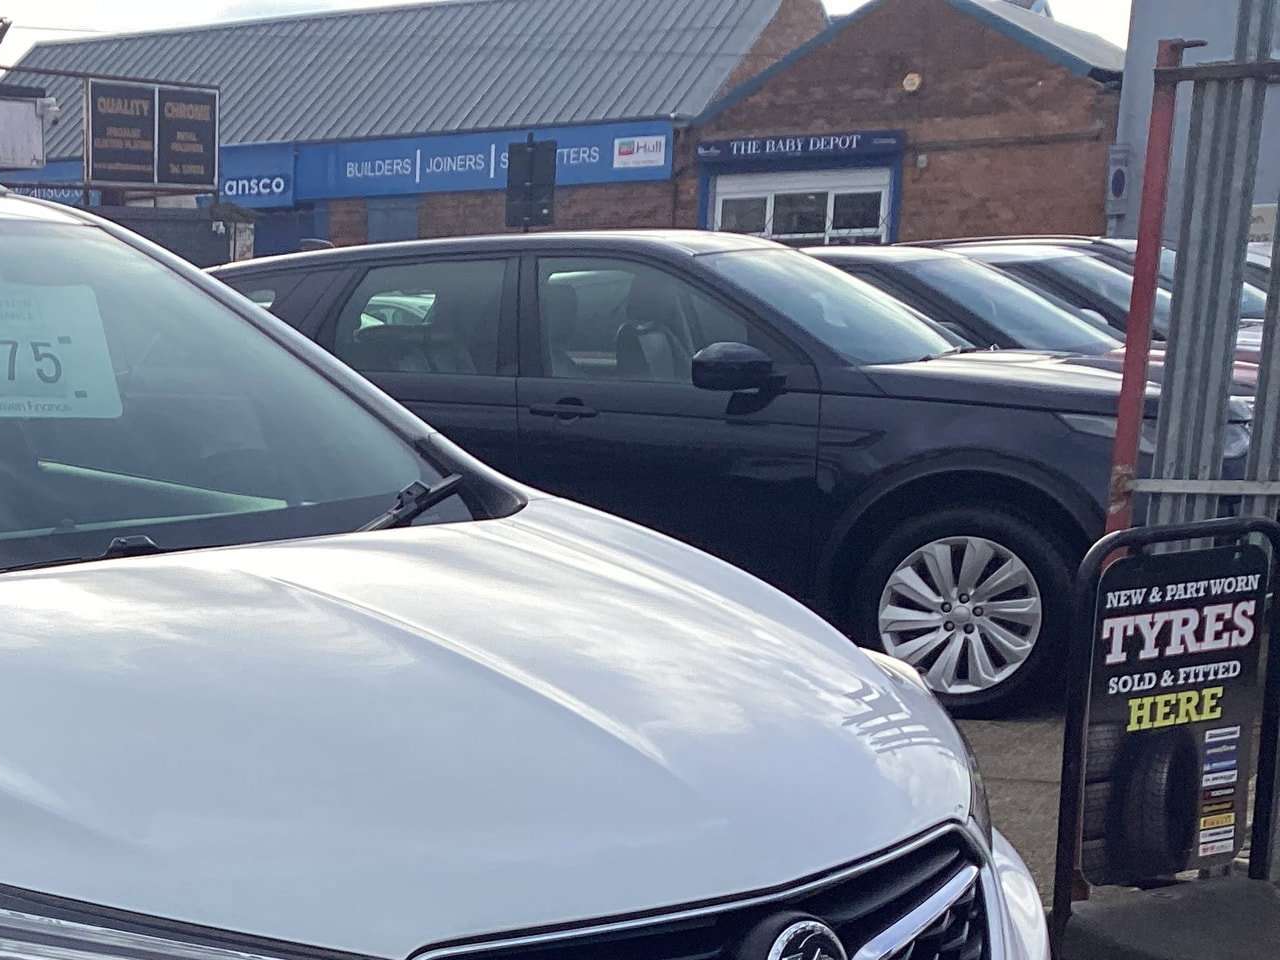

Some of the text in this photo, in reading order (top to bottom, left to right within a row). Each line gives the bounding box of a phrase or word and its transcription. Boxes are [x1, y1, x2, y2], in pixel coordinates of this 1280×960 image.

[636, 140, 662, 153] Hull
[730, 140, 761, 155] THE
[765, 138, 804, 153] BABY
[808, 134, 861, 151] DEPOT
[346, 158, 412, 178] BUILDERS
[426, 154, 485, 174] JOINERS
[221, 177, 285, 196] ansco
[1106, 588, 1147, 608] NEW
[1149, 586, 1162, 602] &
[1102, 600, 1256, 664] TYRES
[1108, 660, 1241, 694] SOLD & FITTED
[1127, 686, 1224, 732] HERE
